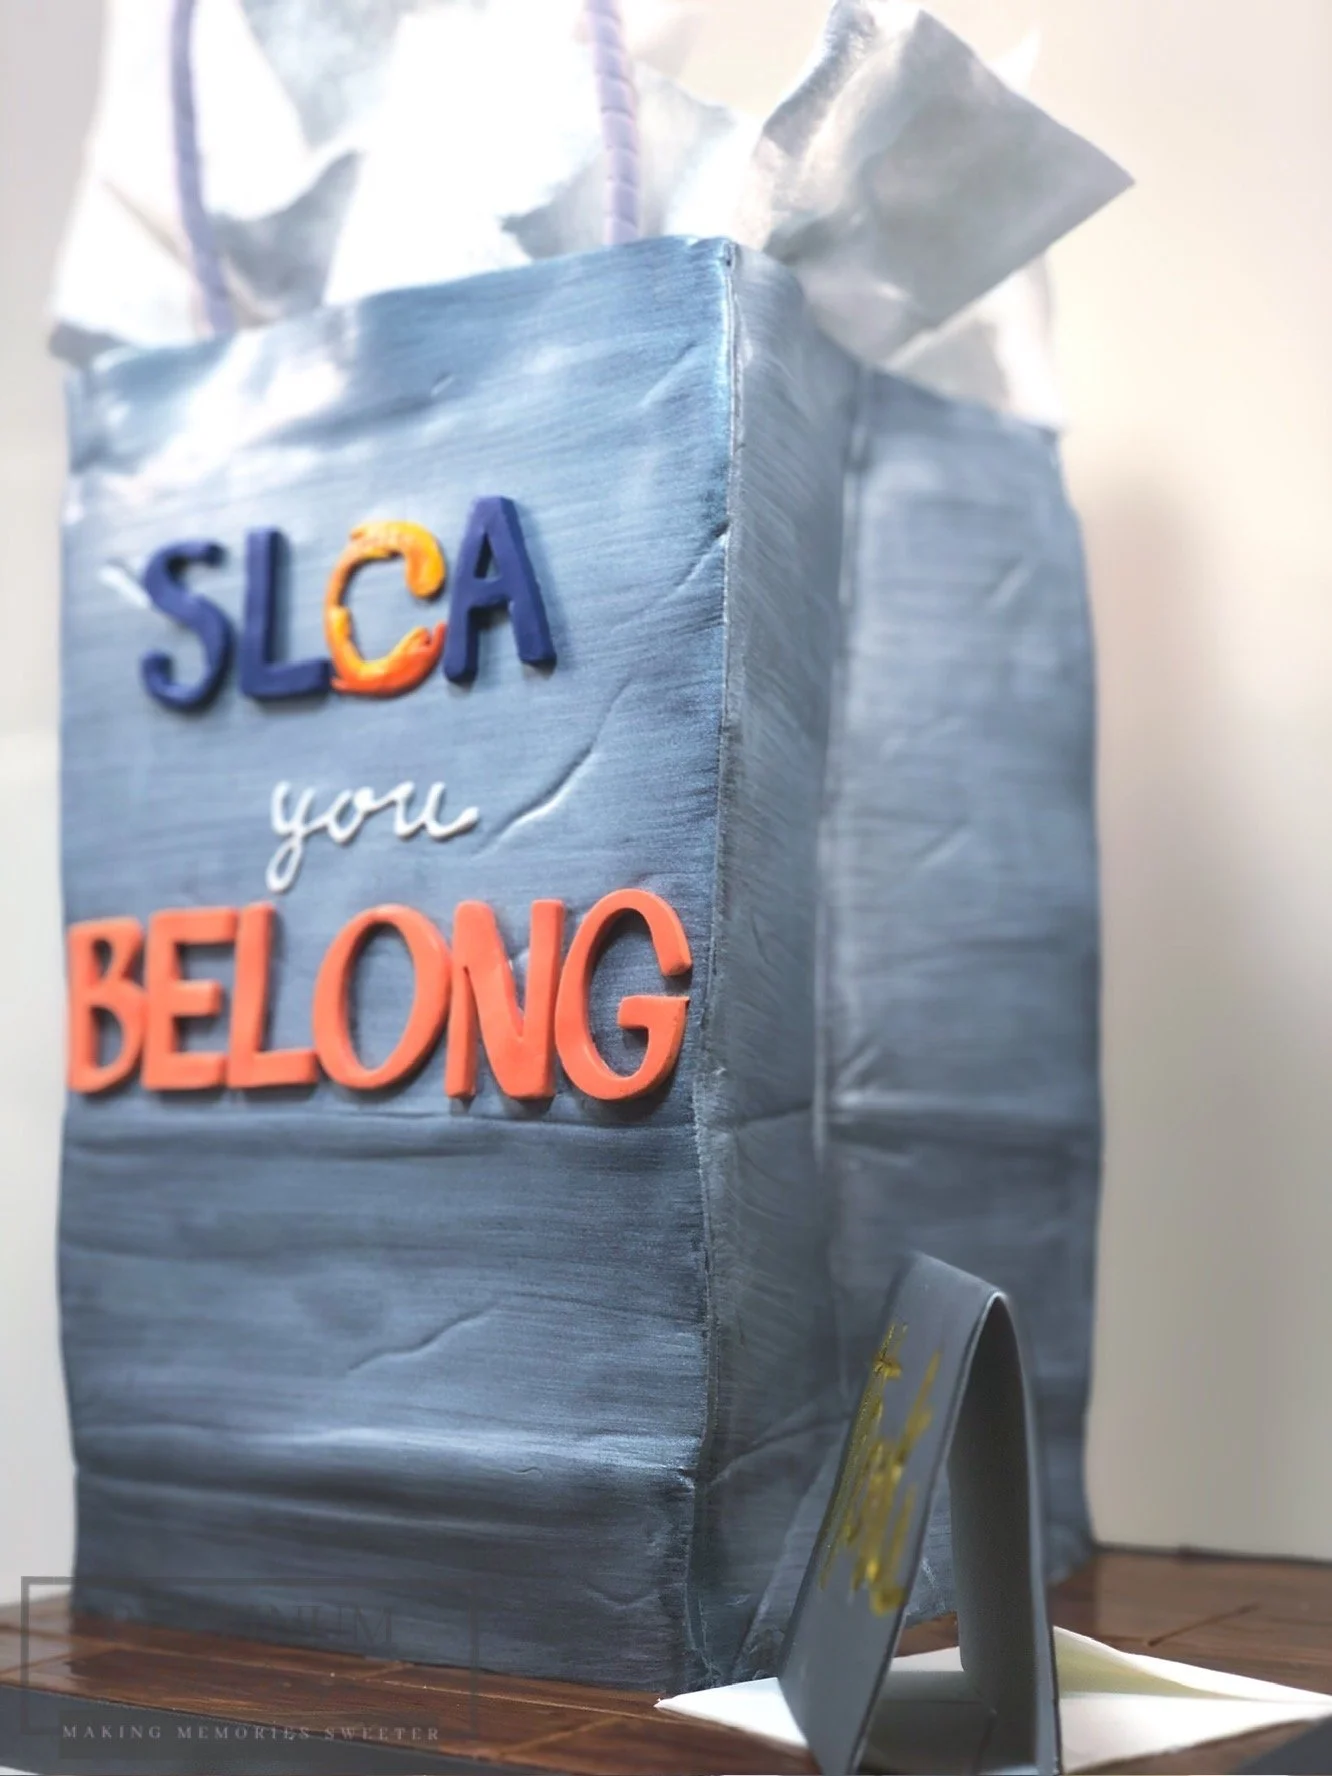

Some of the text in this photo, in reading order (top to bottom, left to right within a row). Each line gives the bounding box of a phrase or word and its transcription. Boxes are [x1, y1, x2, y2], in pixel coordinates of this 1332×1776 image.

[141, 495, 557, 711] SLCA
[266, 781, 481, 894] you
[67, 888, 693, 1101] BELONG
